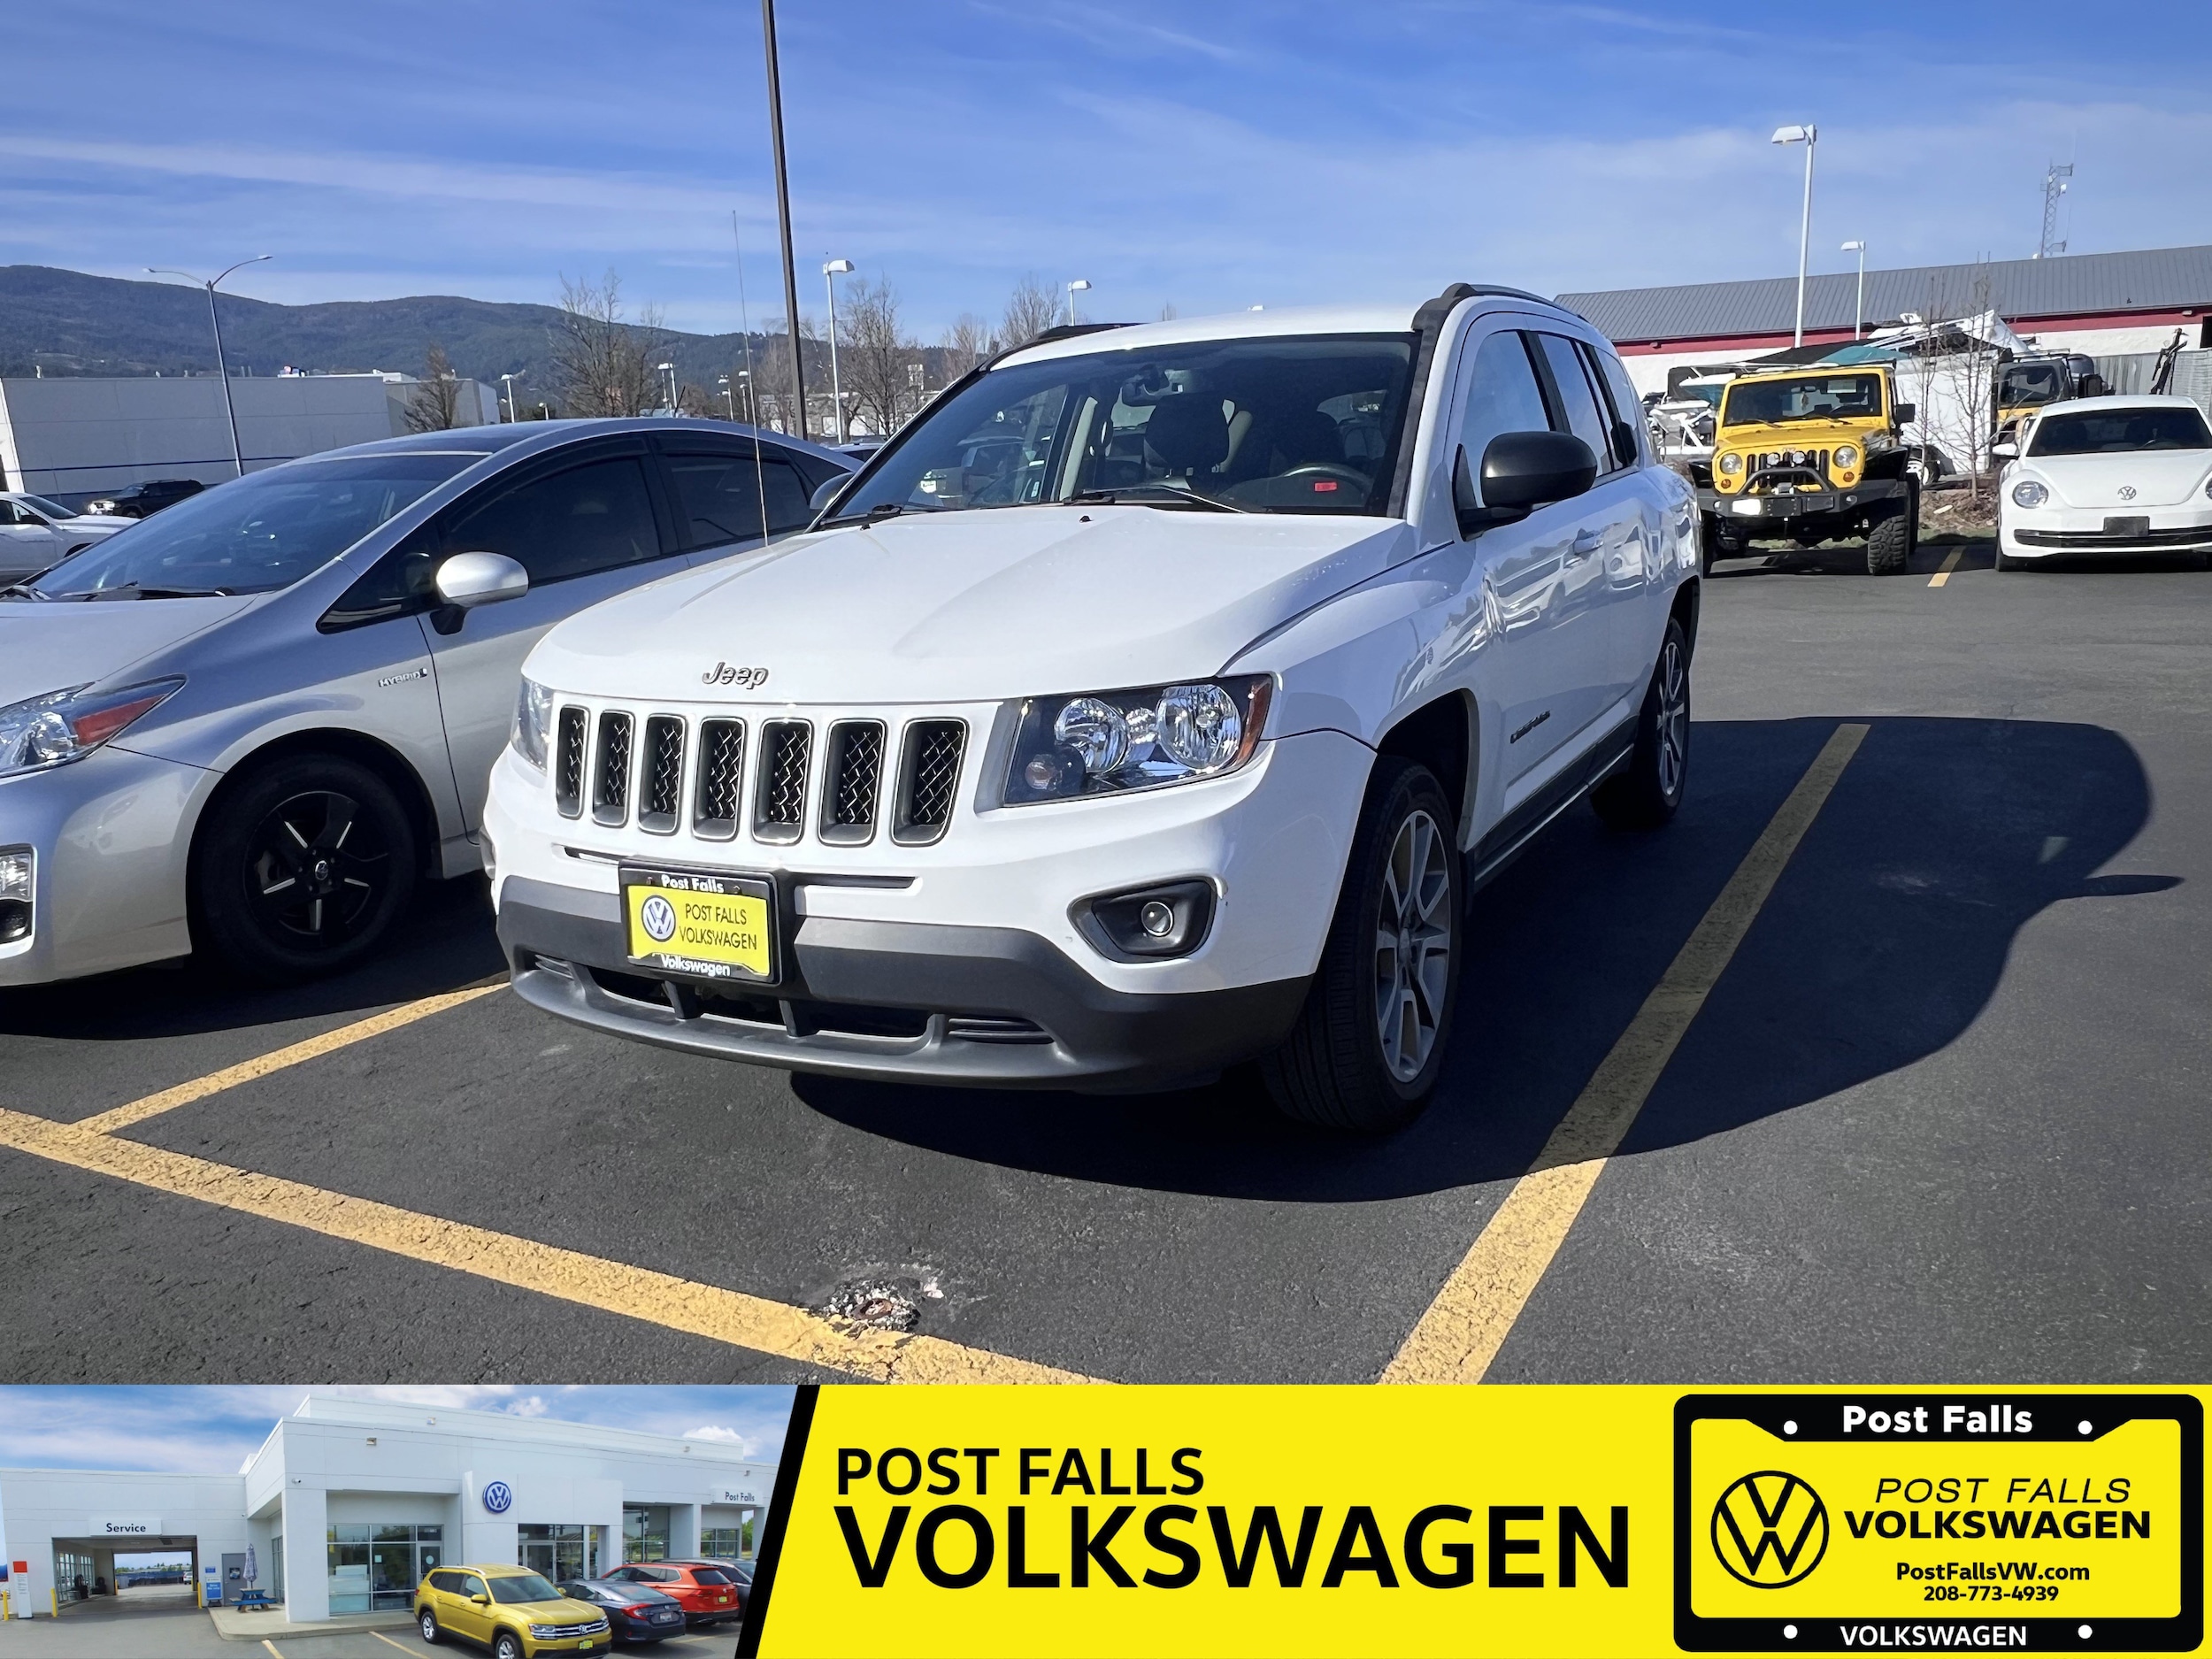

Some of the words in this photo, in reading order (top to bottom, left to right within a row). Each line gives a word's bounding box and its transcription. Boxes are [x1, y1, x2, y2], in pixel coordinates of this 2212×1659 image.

[702, 662, 769, 690] Jeep
[661, 874, 689, 890] Post
[691, 877, 725, 894] Falls
[685, 903, 711, 922] POST
[715, 907, 748, 926] FALLS
[679, 926, 757, 950] VOLKSWAGEN
[661, 954, 731, 977] Volkswagen
[725, 1491, 740, 1502] Post
[740, 1492, 756, 1502] Falls
[105, 1522, 147, 1532] Service
